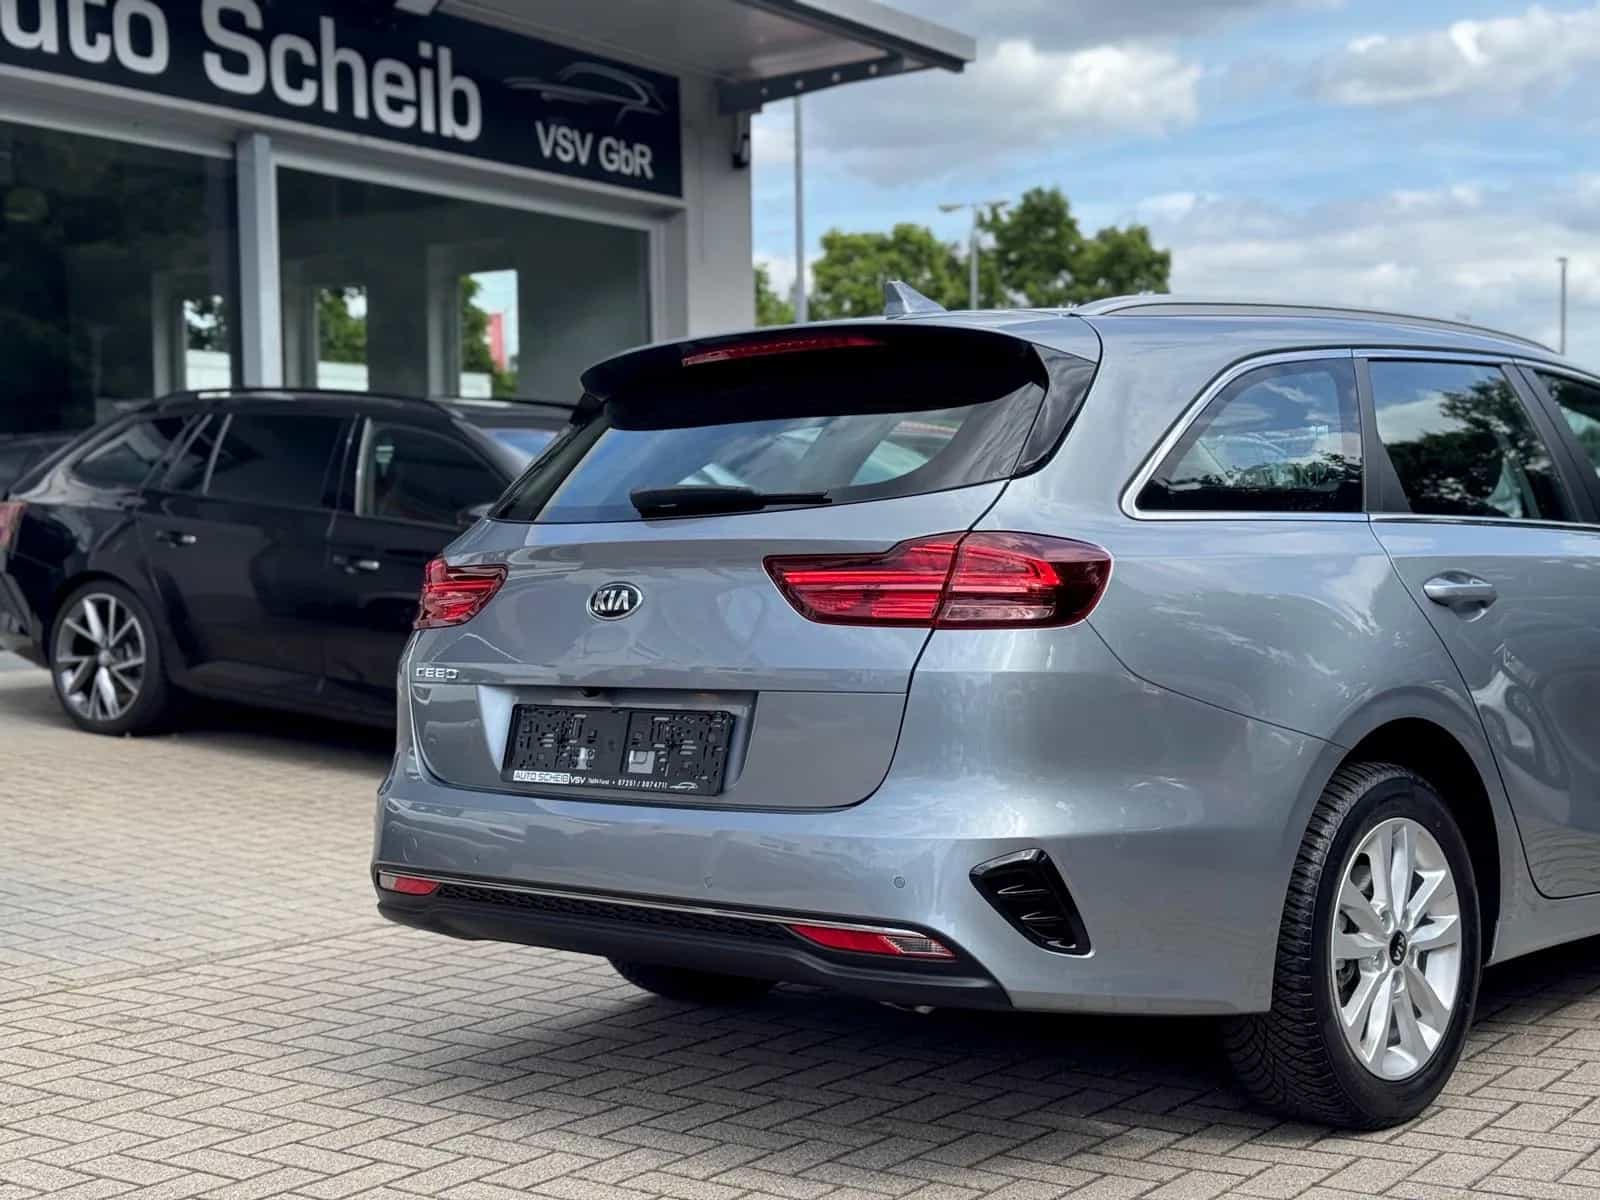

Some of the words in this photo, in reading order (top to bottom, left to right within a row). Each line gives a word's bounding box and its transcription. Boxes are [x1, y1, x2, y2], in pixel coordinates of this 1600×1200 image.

[202, 0, 483, 142] Scheib
[535, 120, 593, 166] VSV
[598, 136, 655, 180] GbR
[593, 590, 630, 611] KIA
[514, 770, 536, 782] AUTO
[536, 772, 570, 784] SCHEIB
[570, 775, 586, 785] VSV
